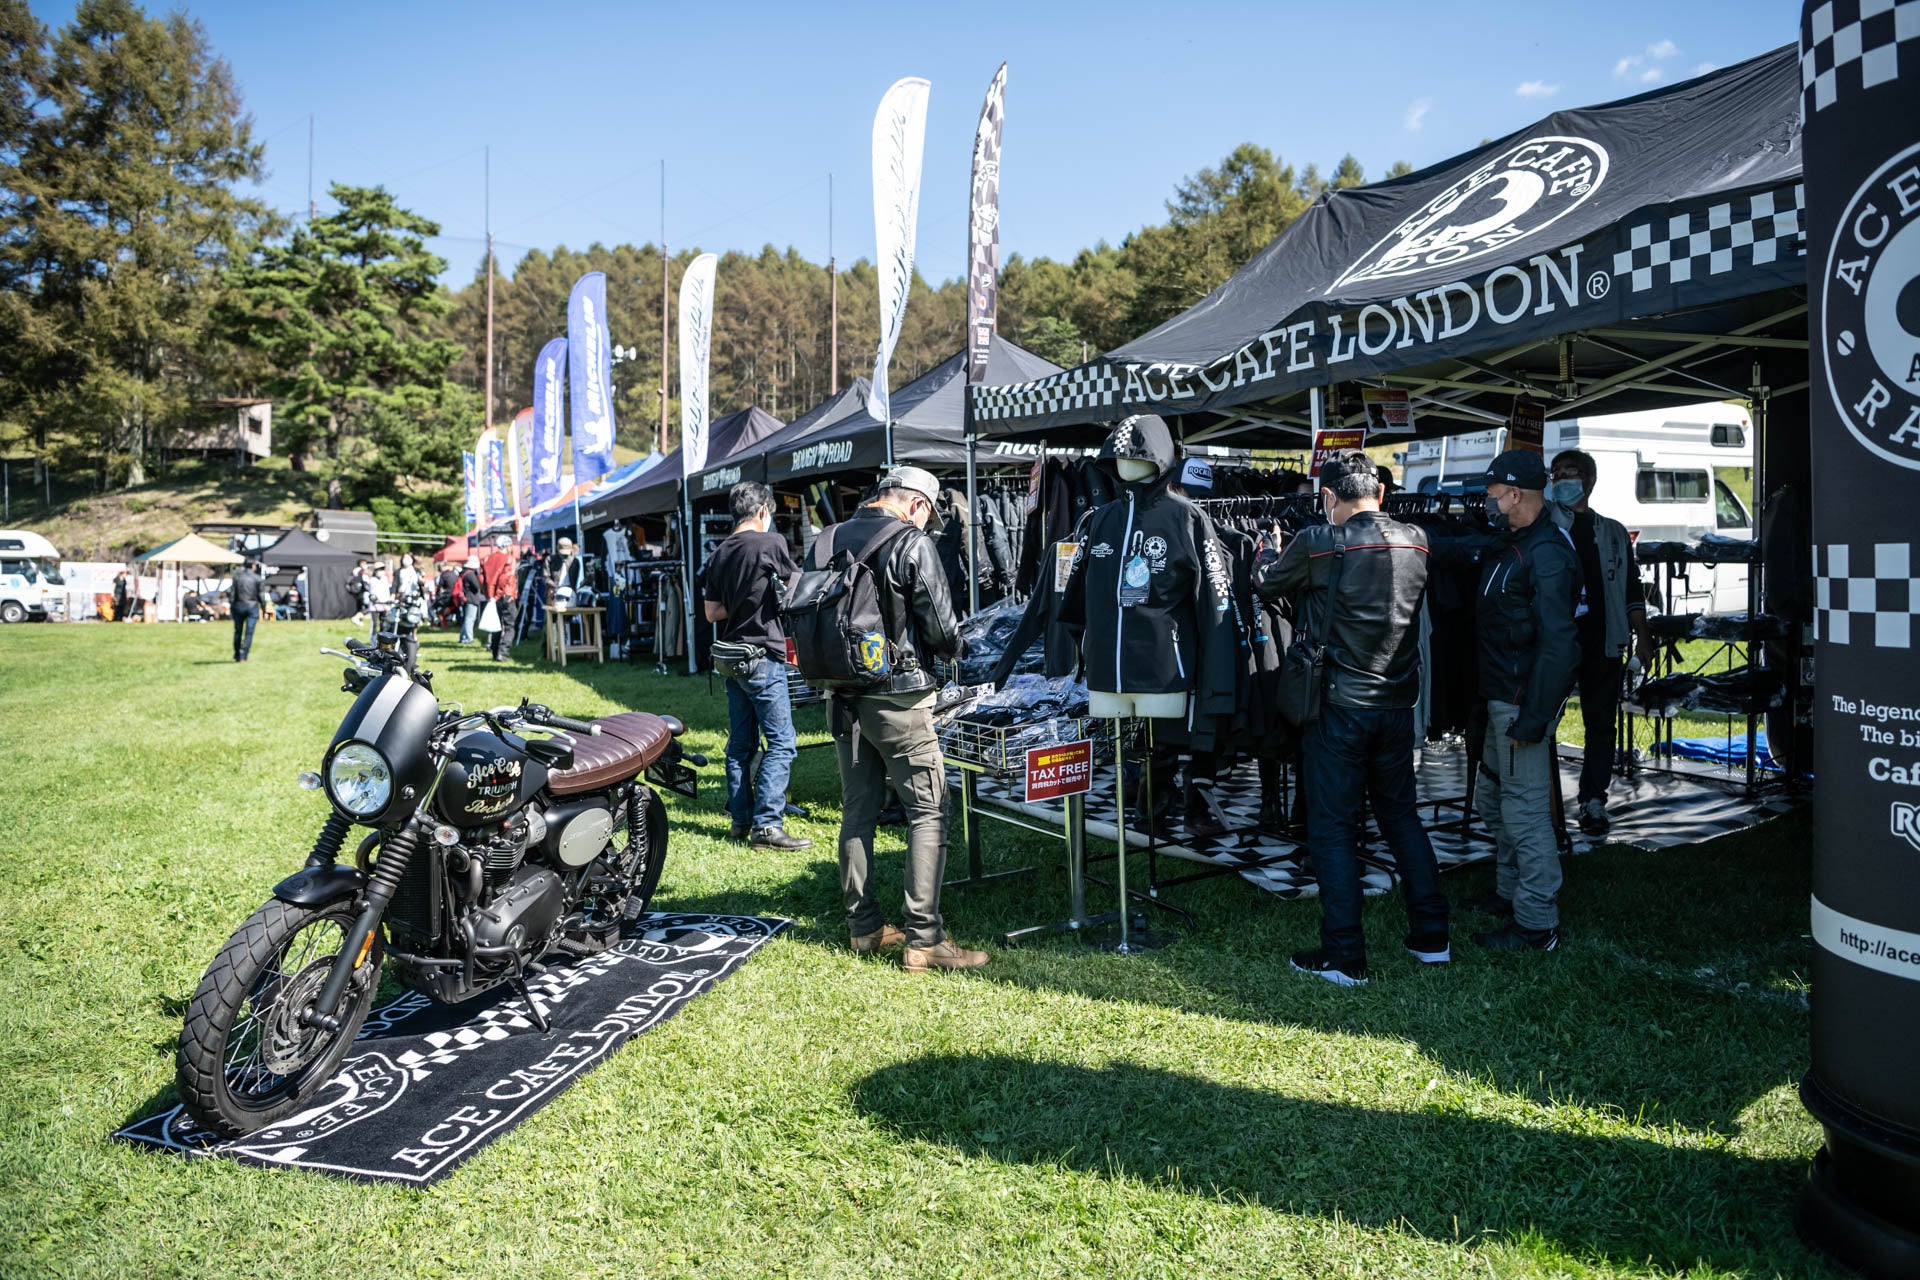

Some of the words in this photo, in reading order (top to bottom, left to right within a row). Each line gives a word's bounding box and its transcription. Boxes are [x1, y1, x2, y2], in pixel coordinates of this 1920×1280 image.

[1123, 363, 1207, 404] ACE
[1199, 320, 1316, 393] CAFE
[790, 445, 818, 472] ROUGH
[827, 440, 853, 464] ROAD
[1832, 694, 1857, 715] The
[1860, 724, 1895, 745] The
[467, 763, 496, 789] Ace
[1031, 767, 1056, 781] TAX
[1059, 761, 1089, 777] FREE
[477, 780, 518, 796] TRIUMPH
[391, 1106, 502, 1170] ACE
[485, 1042, 593, 1101] CAFE
